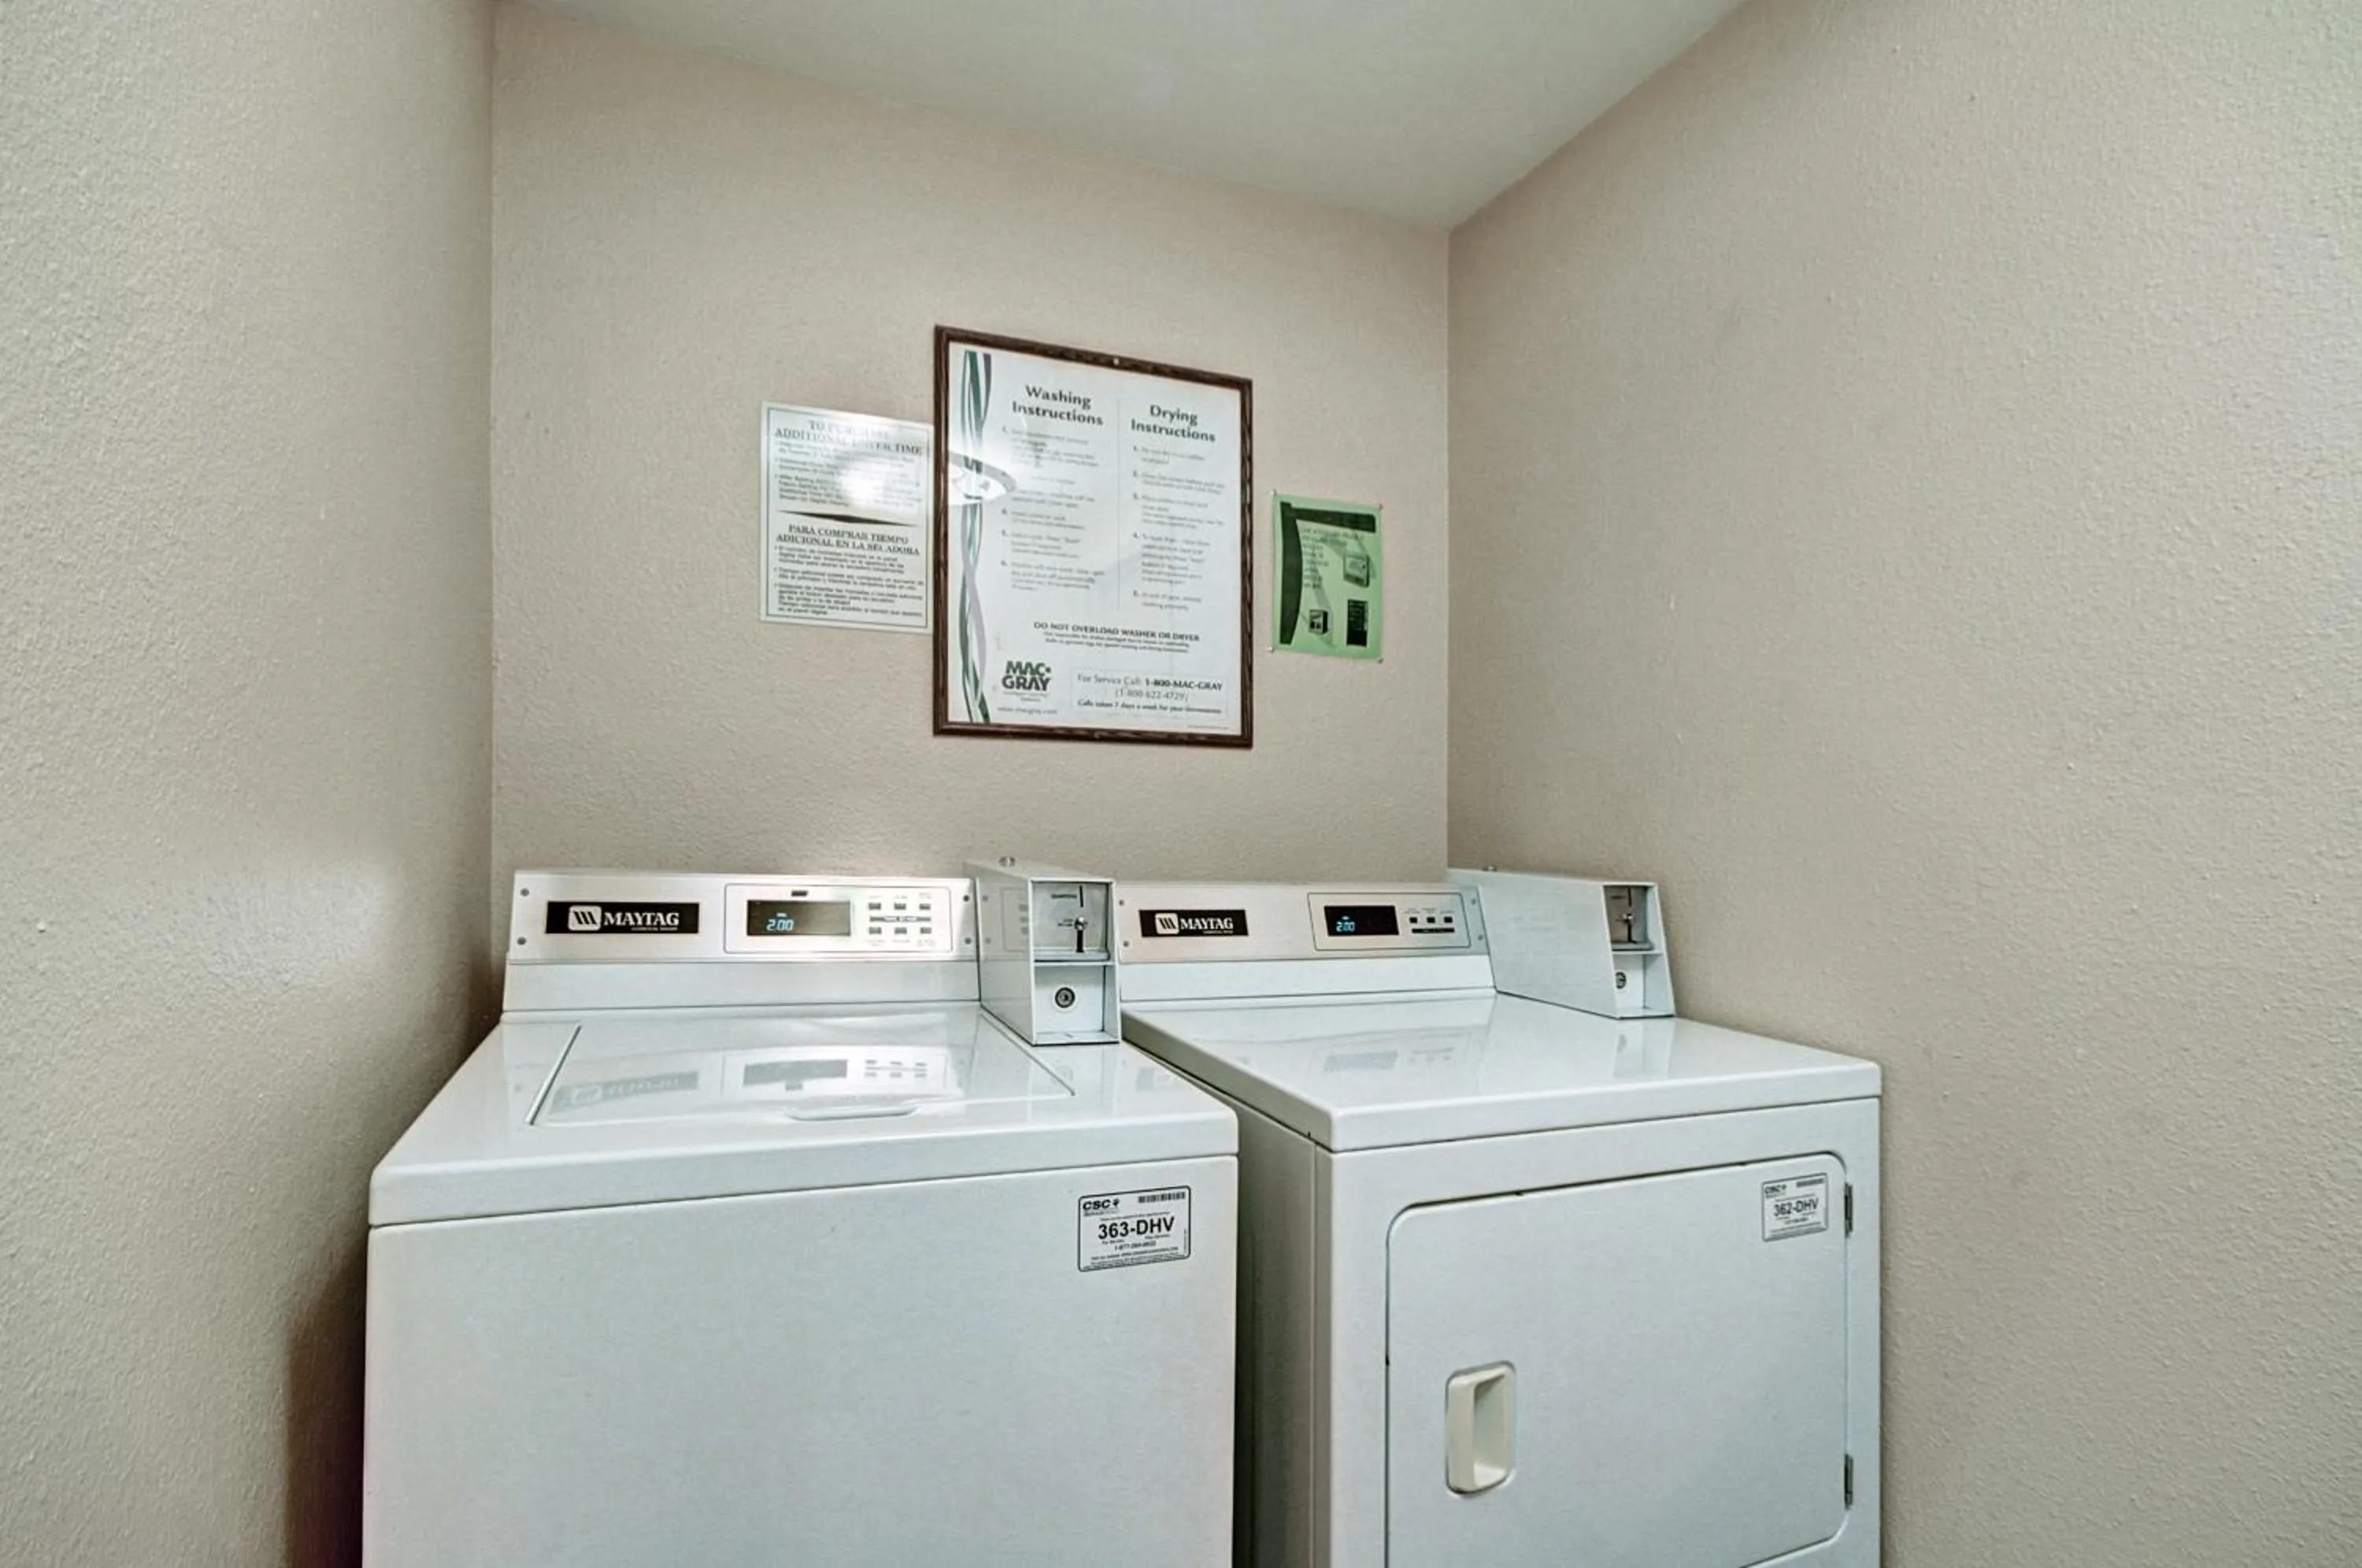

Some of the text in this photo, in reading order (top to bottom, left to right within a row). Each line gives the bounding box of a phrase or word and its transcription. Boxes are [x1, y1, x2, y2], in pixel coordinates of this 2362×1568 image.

[1026, 385, 1091, 410] Washing
[1013, 401, 1104, 426] Instructions
[1150, 405, 1198, 426] Drying
[1131, 419, 1216, 442] Instructions
[895, 442, 922, 455] TIME
[776, 534, 834, 547] ADICIONAL
[835, 540, 850, 549] EN
[851, 541, 865, 551] LA
[788, 523, 909, 545] PARA COMPRAR TIEMPO
[1034, 621, 1048, 630] DO
[1072, 623, 1118, 635] OVERLOAD
[1121, 629, 1156, 638] WASHER
[1172, 632, 1200, 642] DRYER
[1001, 675, 1051, 691] GRAY
[1094, 674, 1121, 684] Service
[1146, 678, 1222, 692] 1-800-MAC-GRAY
[604, 912, 679, 926] MAYTAG
[1180, 917, 1234, 930] MAYTAG
[1083, 1199, 1111, 1211] CSC
[1098, 1216, 1175, 1240] 363-DHV
